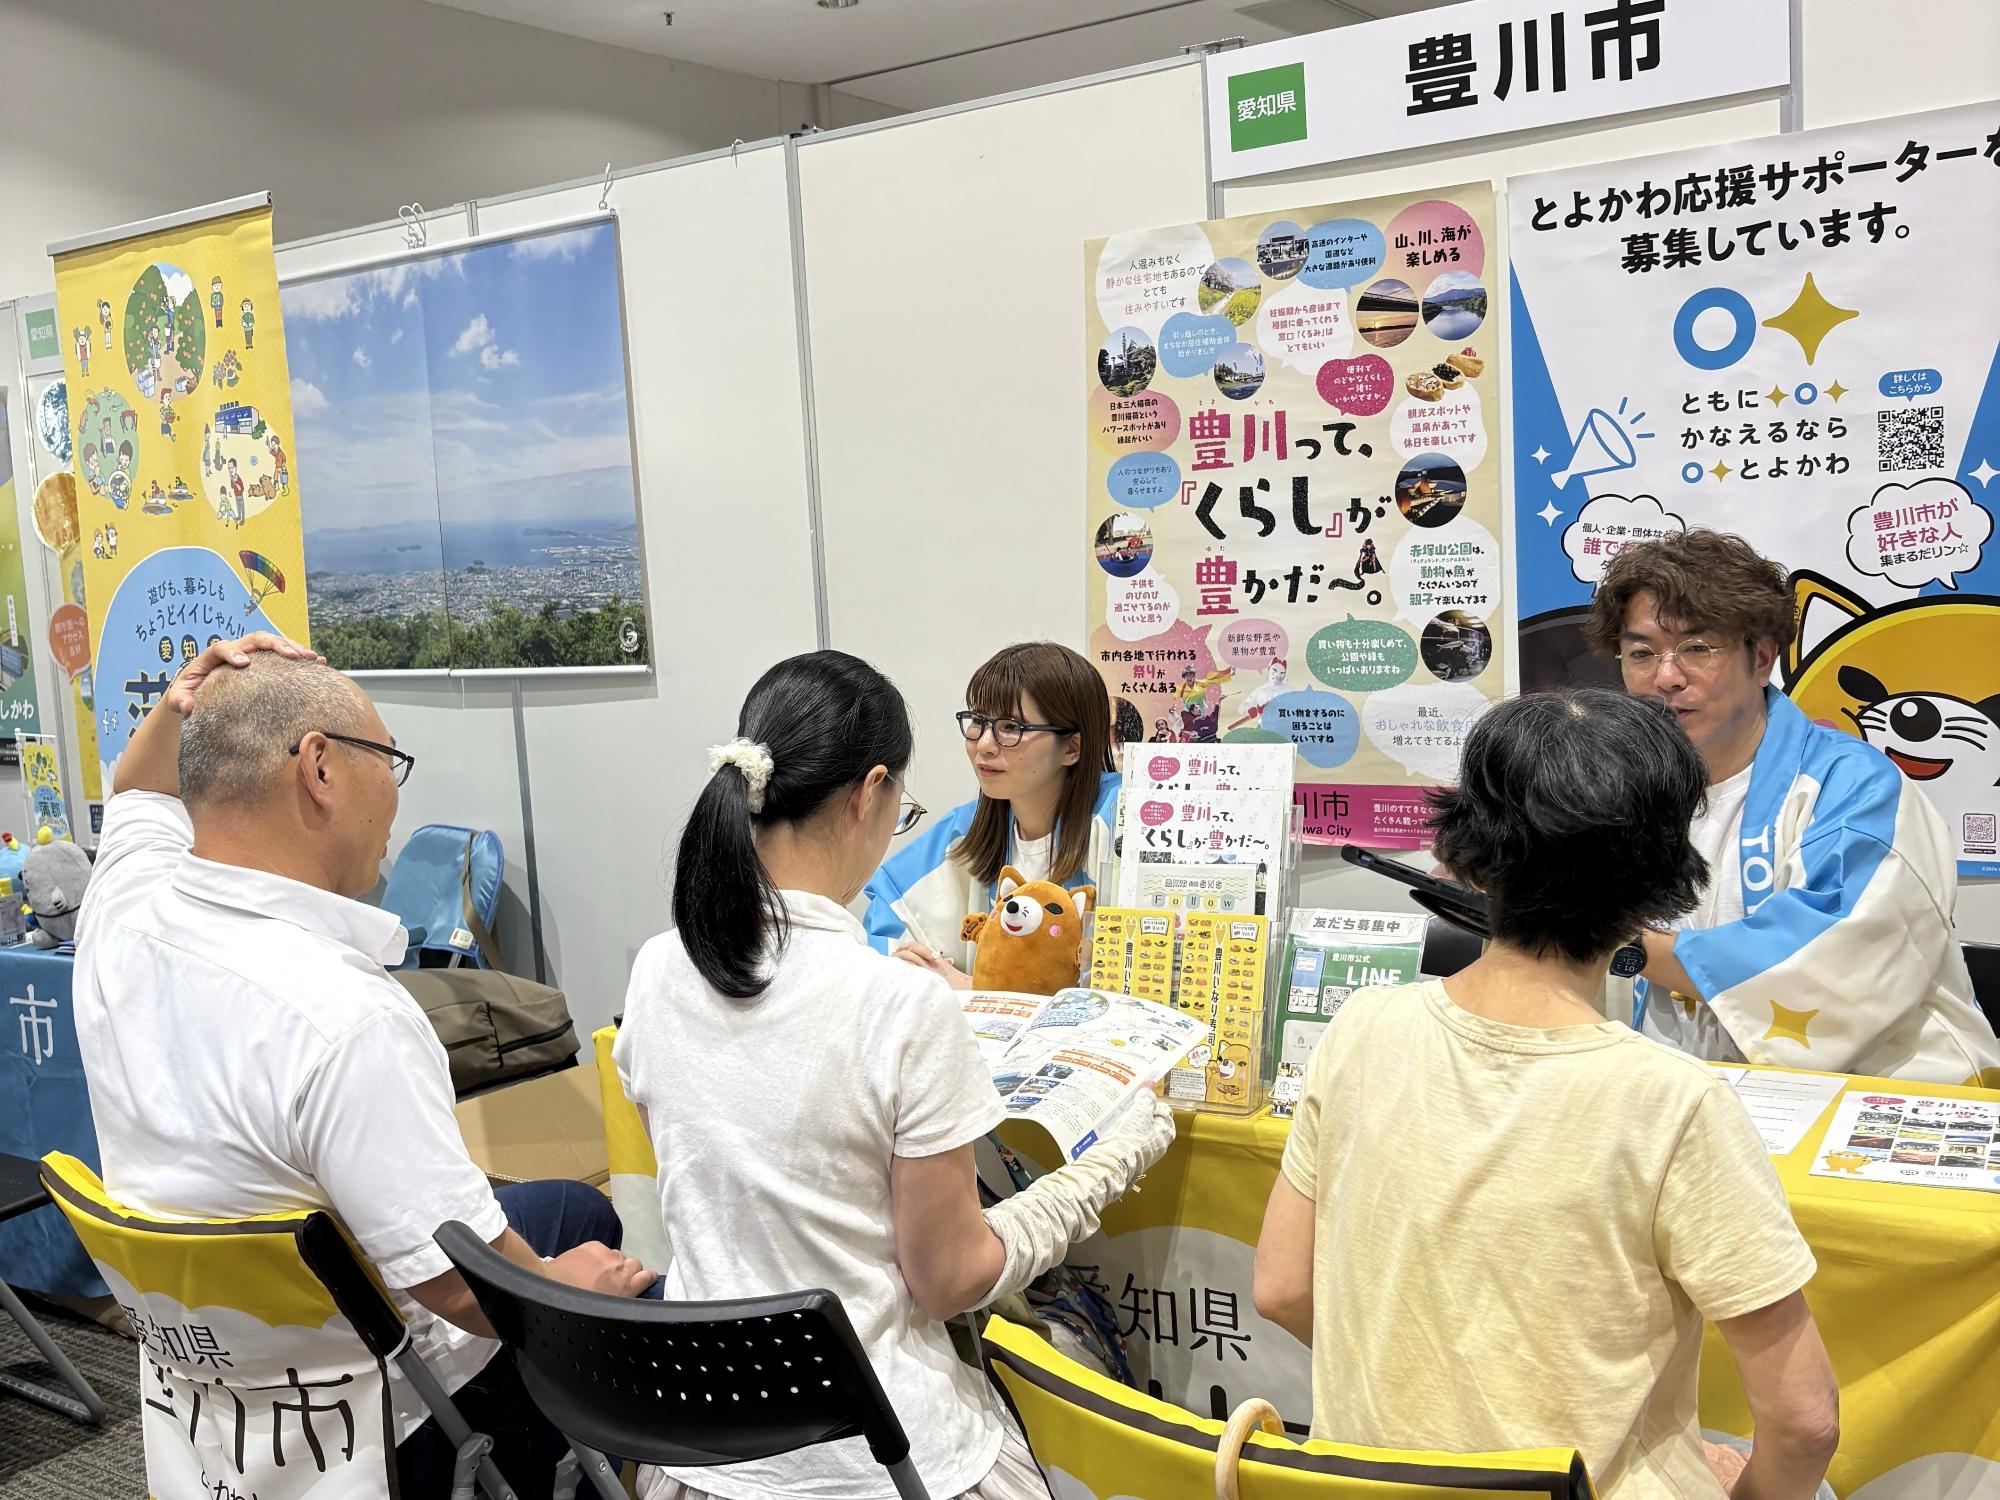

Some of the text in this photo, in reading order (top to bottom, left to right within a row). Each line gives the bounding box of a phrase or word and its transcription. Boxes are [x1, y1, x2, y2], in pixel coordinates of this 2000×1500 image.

[1405, 0, 1665, 116] 豊川市
[1237, 91, 1297, 122] 愛知県
[1311, 233, 1367, 248] 高速のインターや
[1395, 224, 1471, 248] 山、川、海が
[1620, 201, 1910, 275] 募集しています。
[1129, 254, 1182, 271] 人混みもなく
[1406, 247, 1460, 267] 楽しめる
[1304, 257, 1376, 274] 大きな道路があり便利
[1105, 264, 1206, 289] 静かな住宅地もあるので
[1144, 286, 1167, 297] とても
[1125, 297, 1186, 315] 住みやすいです
[1287, 342, 1325, 352] とてもいい
[1894, 372, 1927, 384] 詳しくは
[1890, 383, 1931, 394] こちらから
[1110, 399, 1158, 411] 日本三大稲荷の
[1408, 404, 1471, 419] 観光スポットや
[1111, 410, 1158, 421] 豊川稲荷という
[1103, 421, 1166, 433] パワースポットがあり
[1412, 420, 1467, 433] 温泉があって
[1680, 417, 1847, 449] かなえるなら
[1189, 409, 1373, 471] 豊川って、
[1403, 433, 1476, 448] 休日も楽しいです
[1181, 476, 1392, 540] 『くらし』が
[1873, 498, 1959, 532] 豊川市が
[1877, 522, 1962, 553] 好きな人
[1410, 542, 1484, 557] 赤塚山公園は、
[1420, 565, 1474, 579] 動物や魚が
[1130, 579, 1154, 589] 子供も
[1418, 579, 1478, 589] たくさんいるので
[148, 577, 225, 606] 遊びも、暮らしも
[1125, 592, 1158, 600] のびのび
[1409, 593, 1487, 606] 親子で楽しんでます
[1114, 602, 1170, 612] 過ごせてるのが
[1123, 614, 1162, 623] いいと思う
[1227, 633, 1280, 642] 新鮮な野菜や
[1101, 650, 1196, 662] 市内各地で行われる
[1231, 647, 1276, 656] 果物が豊富
[1133, 665, 1165, 679] 祭りが
[1121, 682, 1177, 693] たくさんある
[1278, 709, 1344, 718] 買い物をするのに
[1417, 707, 1443, 718] 最近、
[1292, 722, 1332, 731] 困ることは
[1291, 735, 1334, 743] ないですね
[1327, 825, 1352, 838] City
[1313, 916, 1401, 933] 友だち募集中
[1346, 966, 1402, 987] LINE
[1208, 947, 1222, 1046] 豊川いなり寿司
[10, 984, 57, 1065] 市
